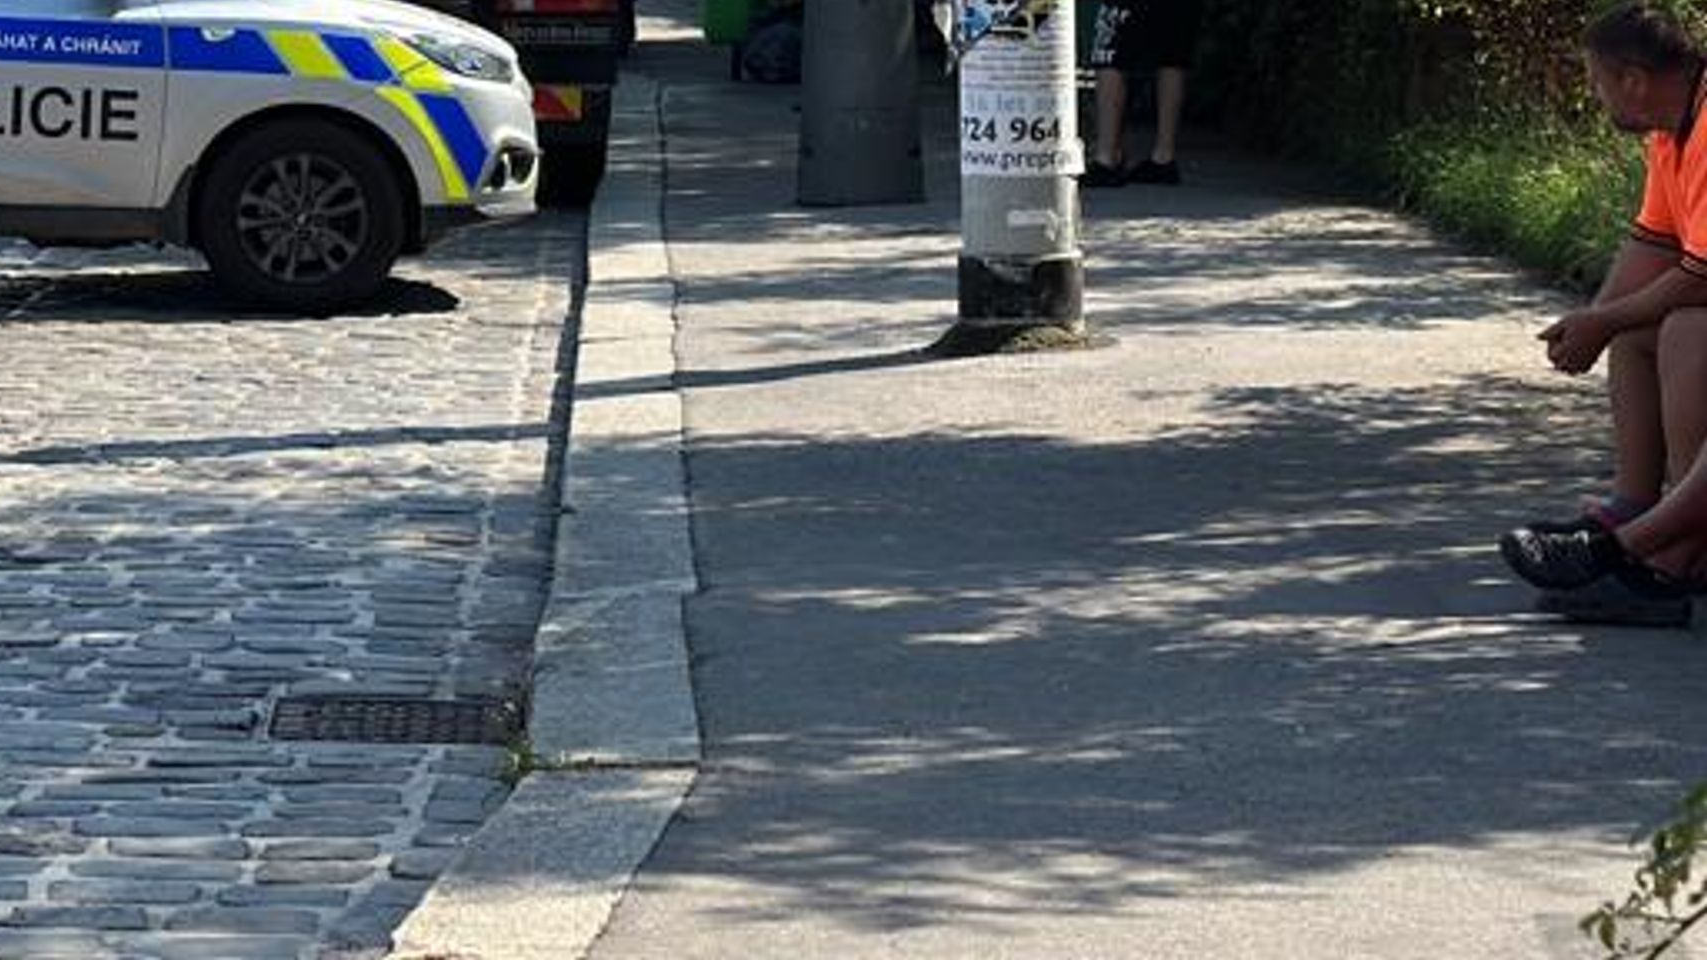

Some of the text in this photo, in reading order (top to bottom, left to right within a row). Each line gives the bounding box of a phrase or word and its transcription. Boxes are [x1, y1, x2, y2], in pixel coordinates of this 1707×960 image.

[43, 39, 57, 51] A
[60, 38, 142, 56] CHRÁNIT
[1009, 116, 1062, 143] 964
